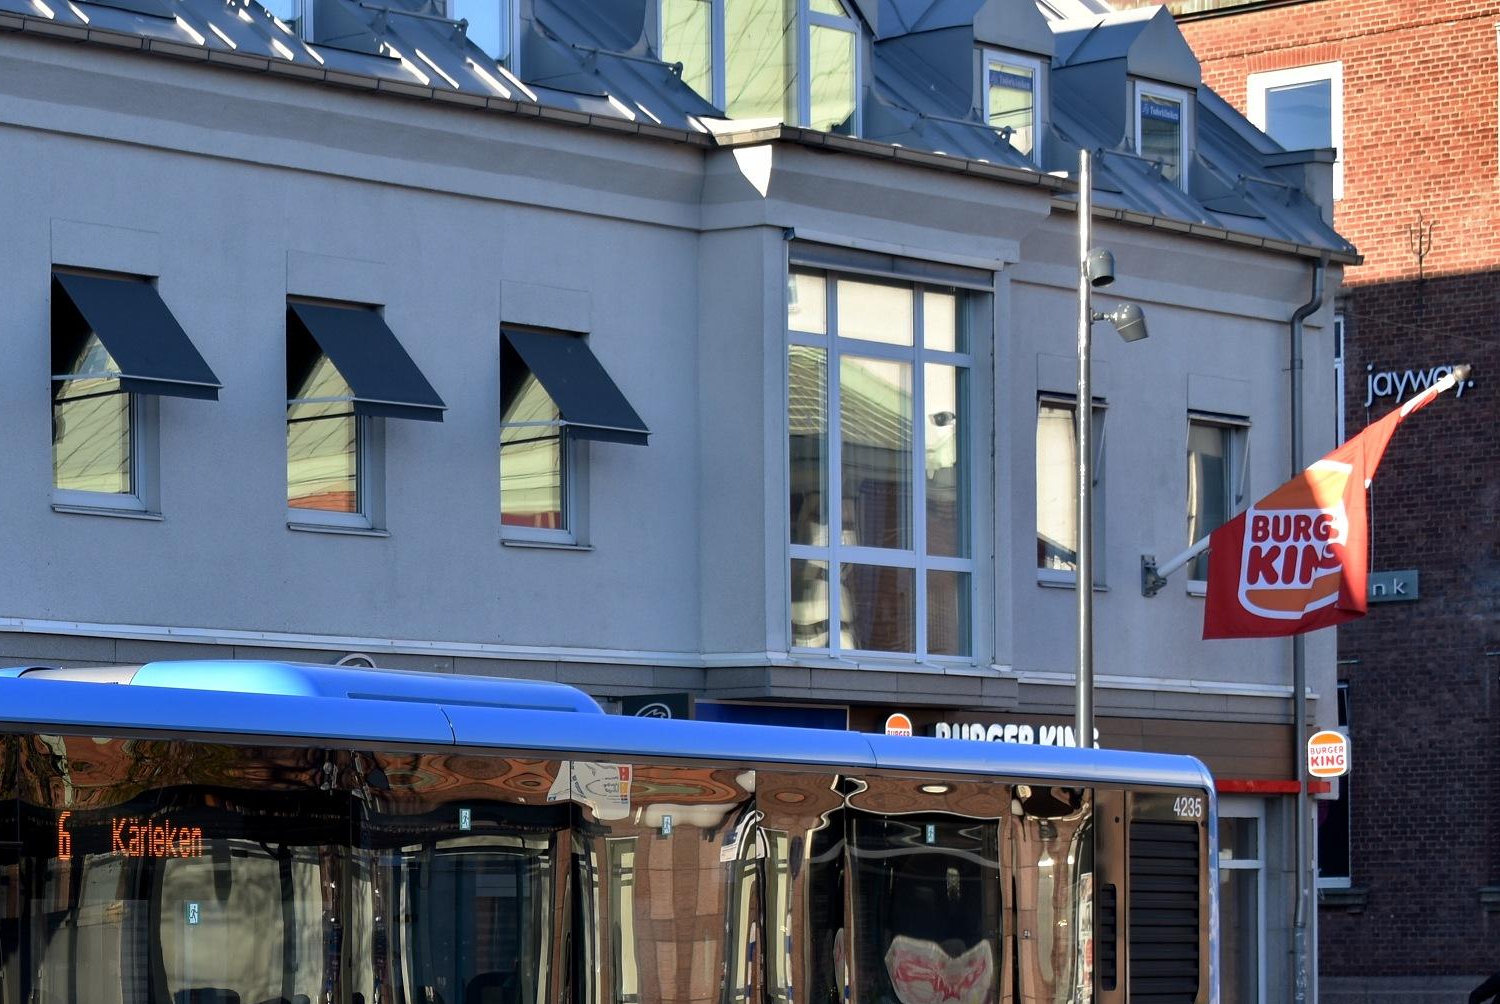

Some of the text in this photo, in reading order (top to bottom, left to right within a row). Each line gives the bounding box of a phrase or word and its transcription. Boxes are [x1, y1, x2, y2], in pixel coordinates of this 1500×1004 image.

[1251, 513, 1338, 543] BURG
[1310, 746, 1344, 755] BURGER
[1310, 755, 1345, 767] KING
[1173, 797, 1202, 818] 4235
[59, 811, 202, 860] 6 Kärleken
